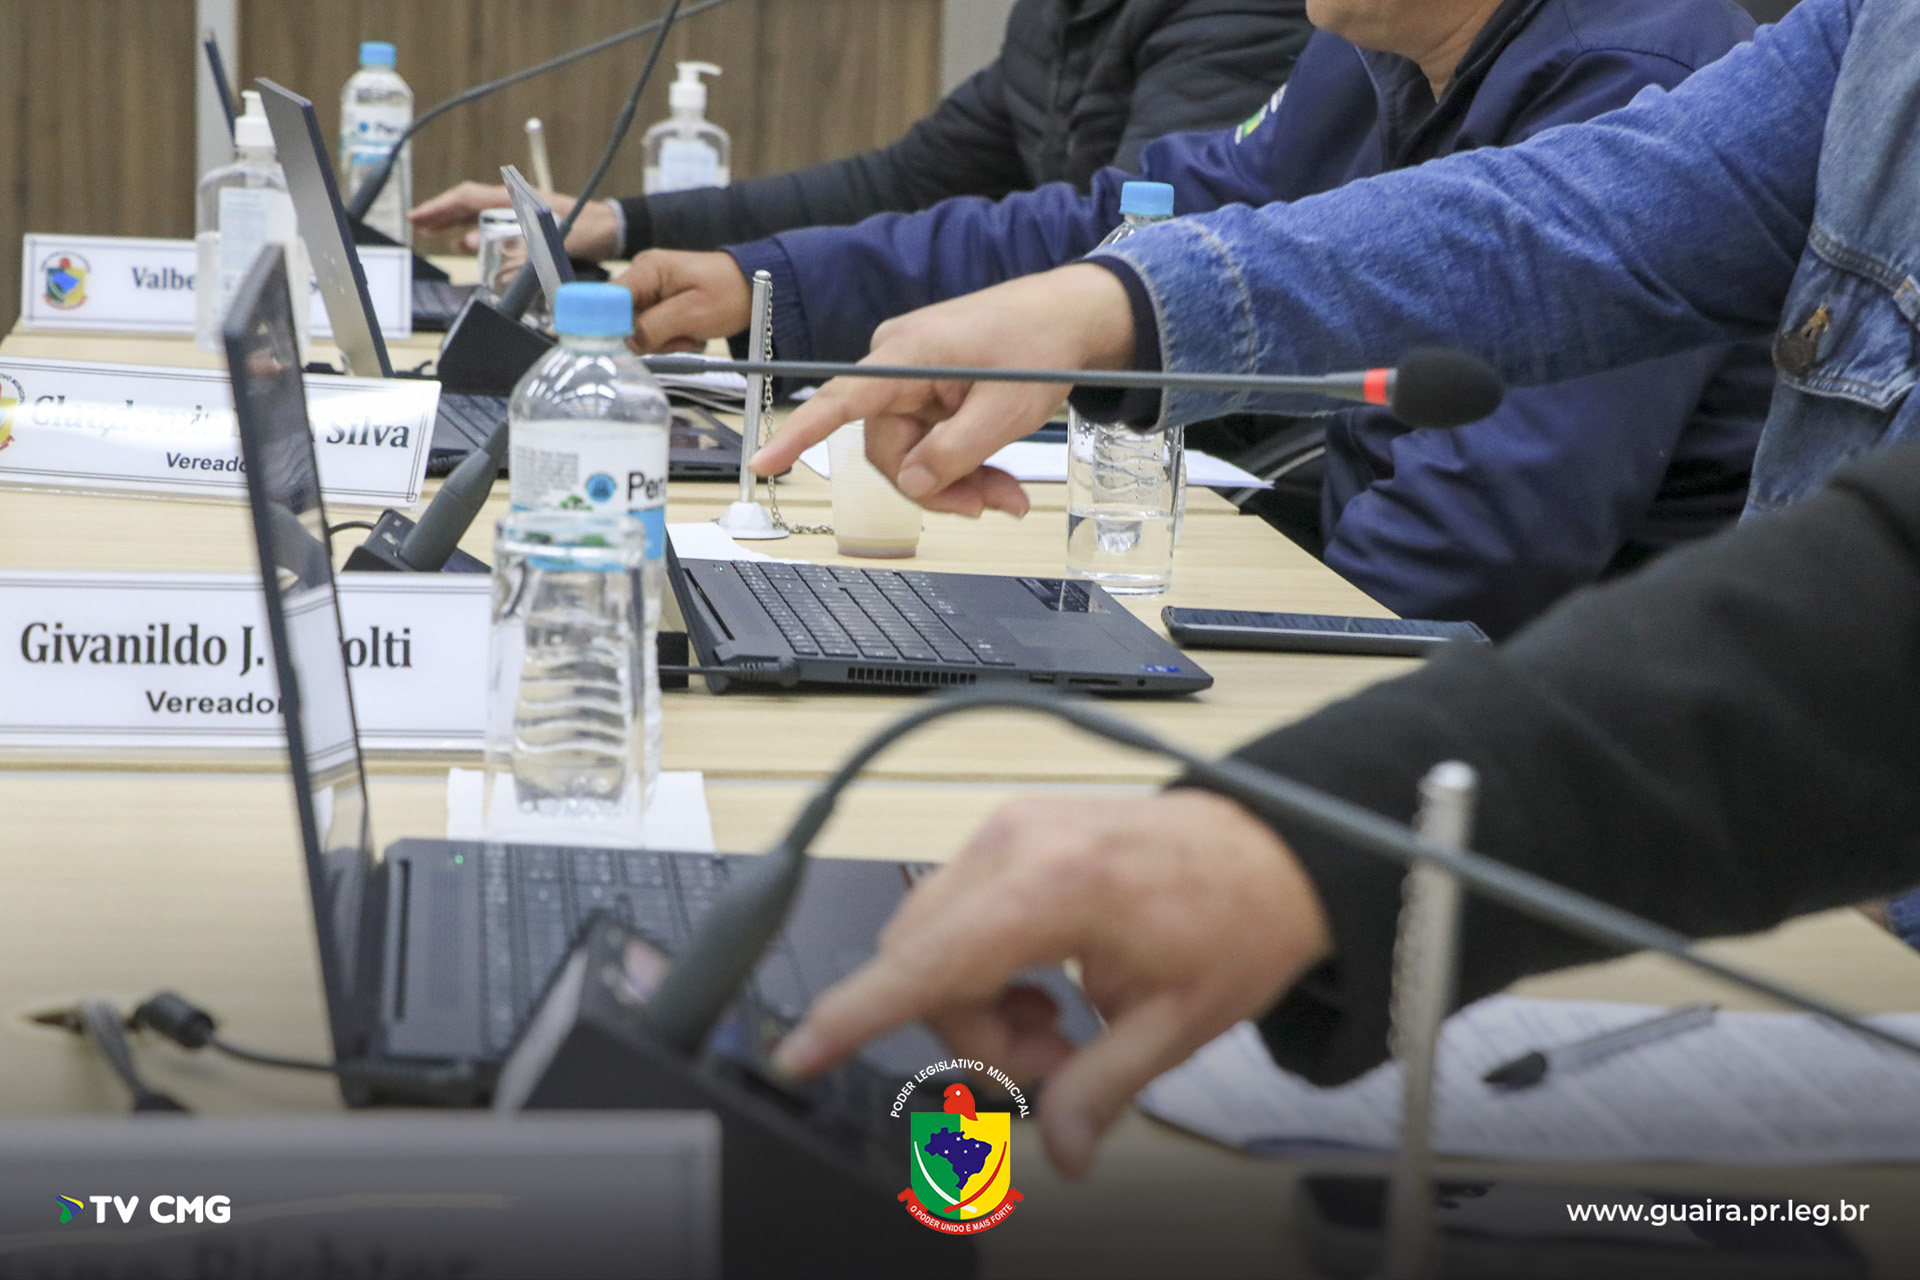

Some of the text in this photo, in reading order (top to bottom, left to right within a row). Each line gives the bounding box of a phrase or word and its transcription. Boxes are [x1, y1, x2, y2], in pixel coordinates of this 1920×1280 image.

[326, 416, 410, 448] Silva
[166, 452, 249, 473] Vereado
[20, 622, 228, 666] Givanildo
[239, 626, 265, 676] J.
